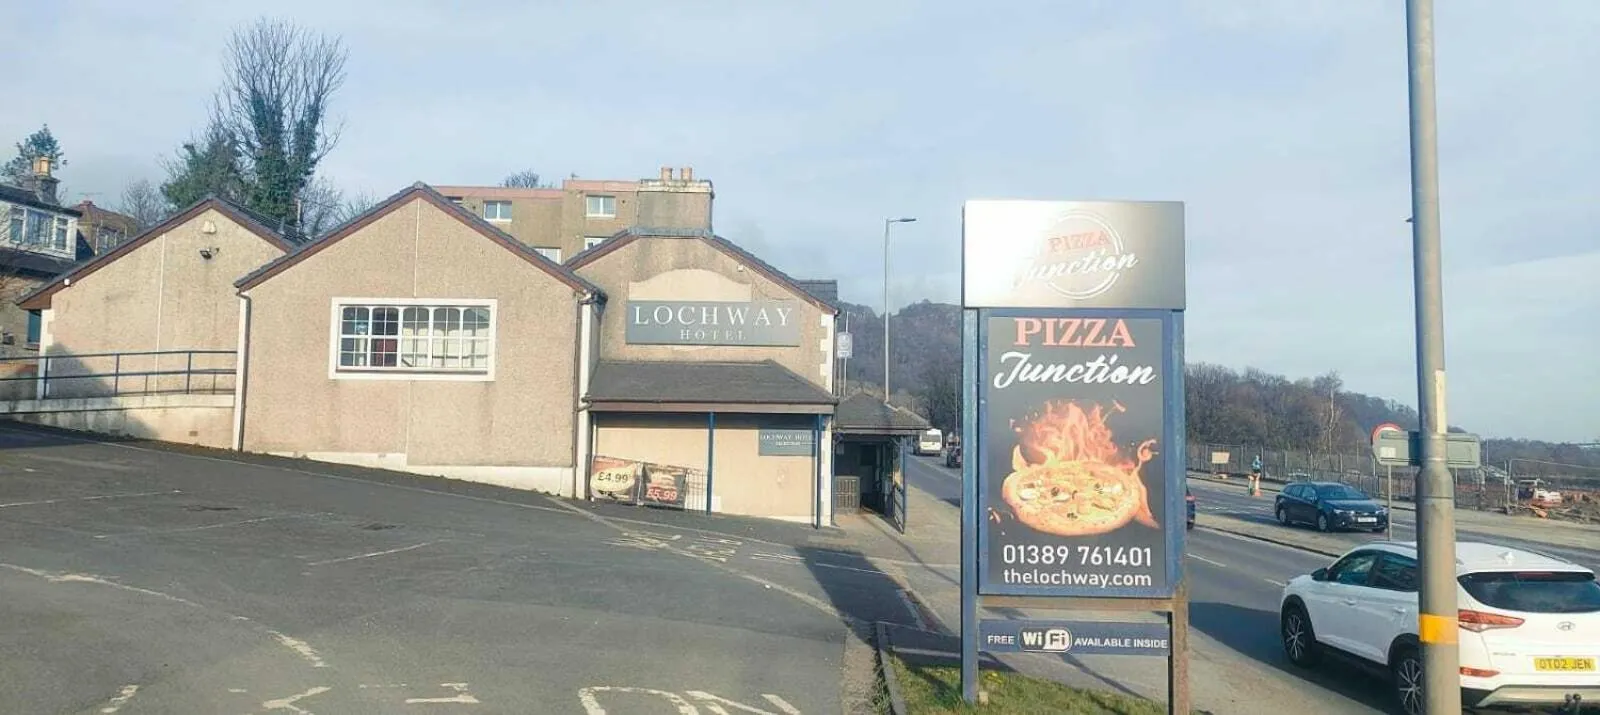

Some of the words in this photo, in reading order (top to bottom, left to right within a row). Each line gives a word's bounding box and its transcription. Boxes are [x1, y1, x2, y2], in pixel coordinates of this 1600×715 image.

[1047, 230, 1113, 251] PIZZA
[1012, 249, 1139, 288] Junction
[634, 305, 793, 327] LOCHWAY
[680, 329, 747, 341] HOTEL
[1013, 317, 1136, 347] PIZZA
[993, 351, 1157, 389] Junction
[597, 471, 629, 483] £4.99
[1002, 544, 1070, 565] 01389
[1077, 546, 1153, 567] 761401
[1003, 568, 1153, 588] thelochway.com
[987, 635, 1015, 646] FREE
[1074, 638, 1131, 649] AVAILABLE
[1133, 639, 1169, 650] INSIDE
